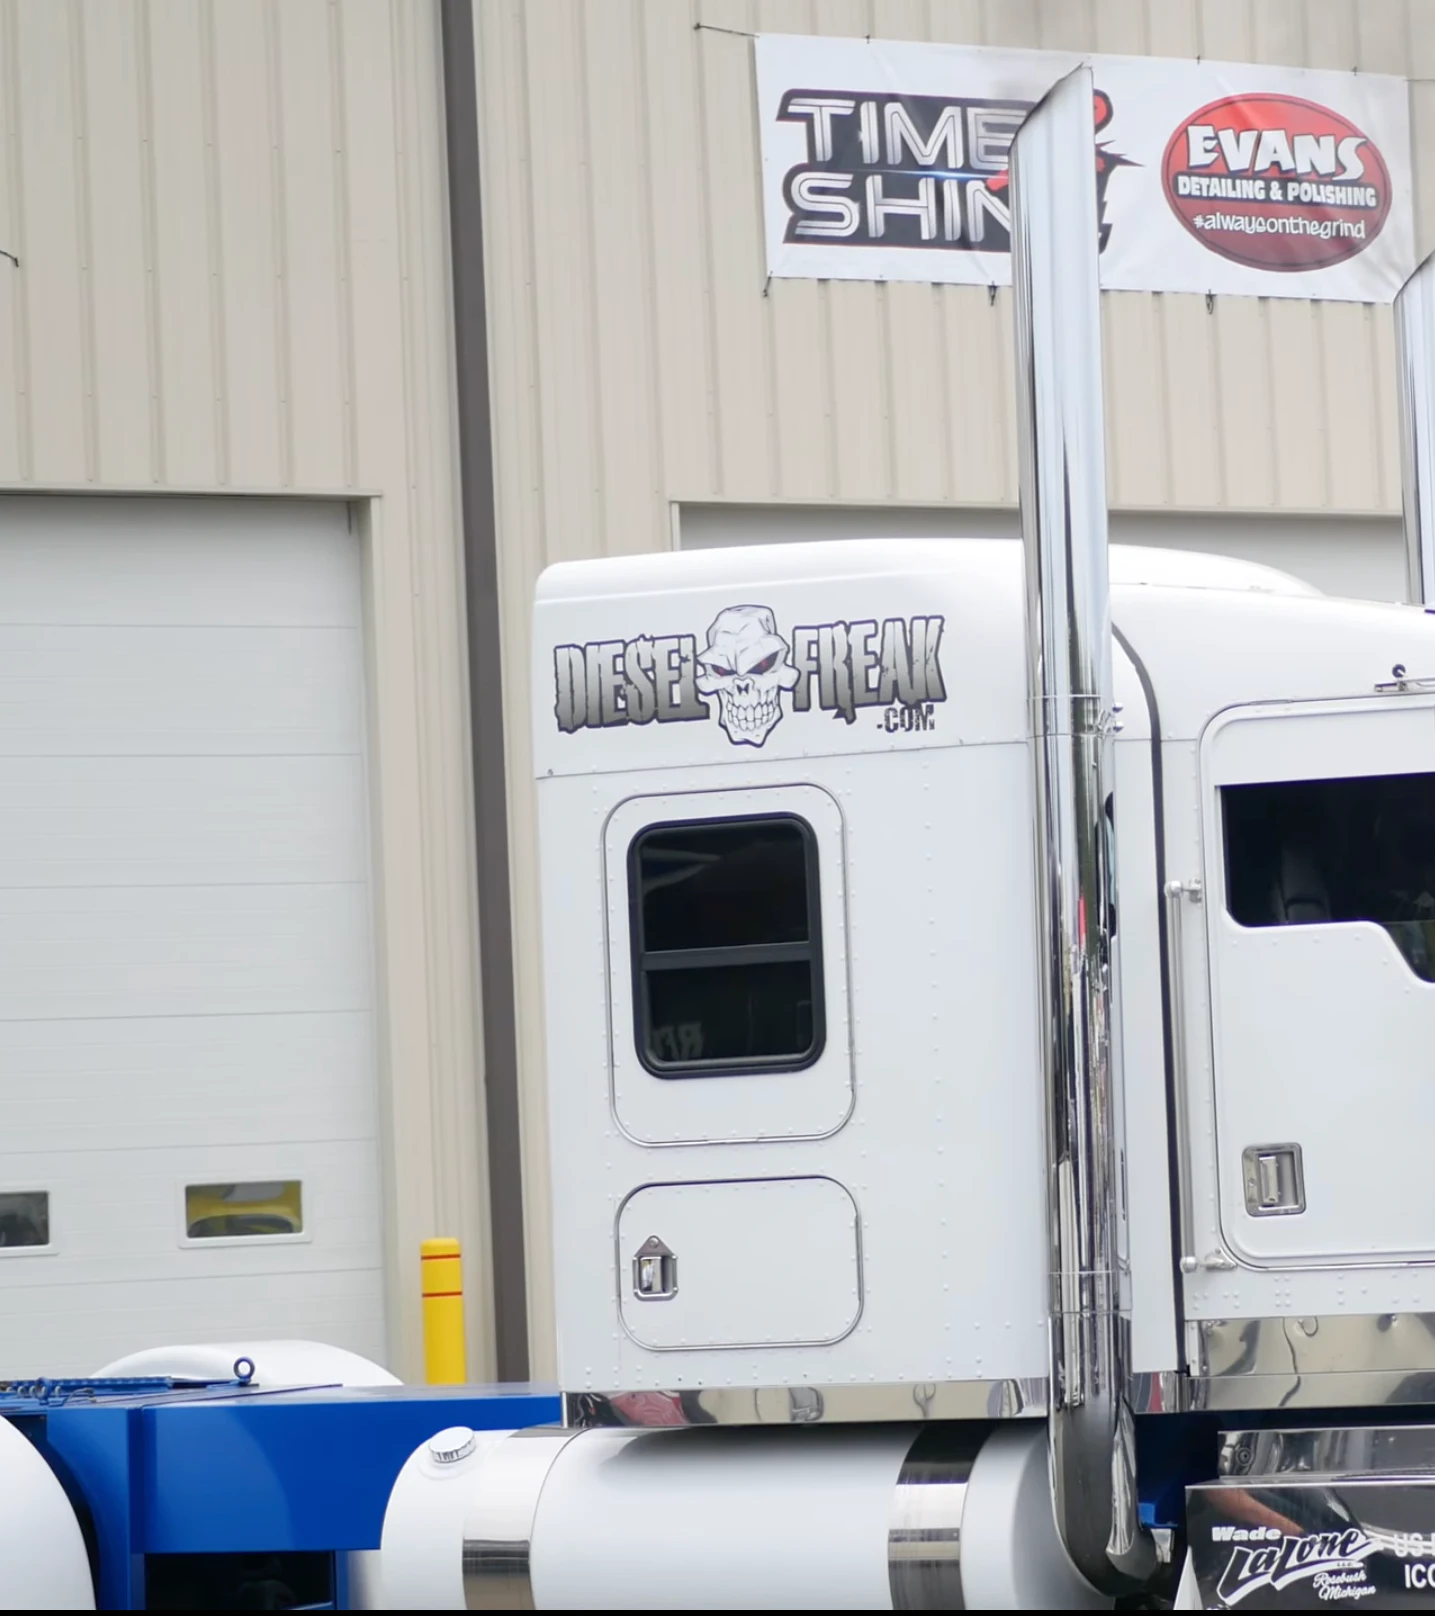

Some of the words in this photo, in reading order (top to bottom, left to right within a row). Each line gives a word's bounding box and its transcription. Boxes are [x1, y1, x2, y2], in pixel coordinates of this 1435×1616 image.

[786, 97, 1027, 170] TIME
[1186, 124, 1368, 181] EVANS
[1177, 175, 1266, 200] DETAILING
[1269, 181, 1283, 201] &
[1287, 181, 1378, 207] POLISHING
[790, 173, 1011, 243] SHIN
[1193, 211, 1366, 239] #alwaysonthegrind
[554, 634, 710, 734] DIESEL
[792, 615, 947, 724] FREAK
[1212, 1526, 1282, 1542] Wade
[1394, 1532, 1423, 1558] US
[1318, 1585, 1377, 1600] Michigan
